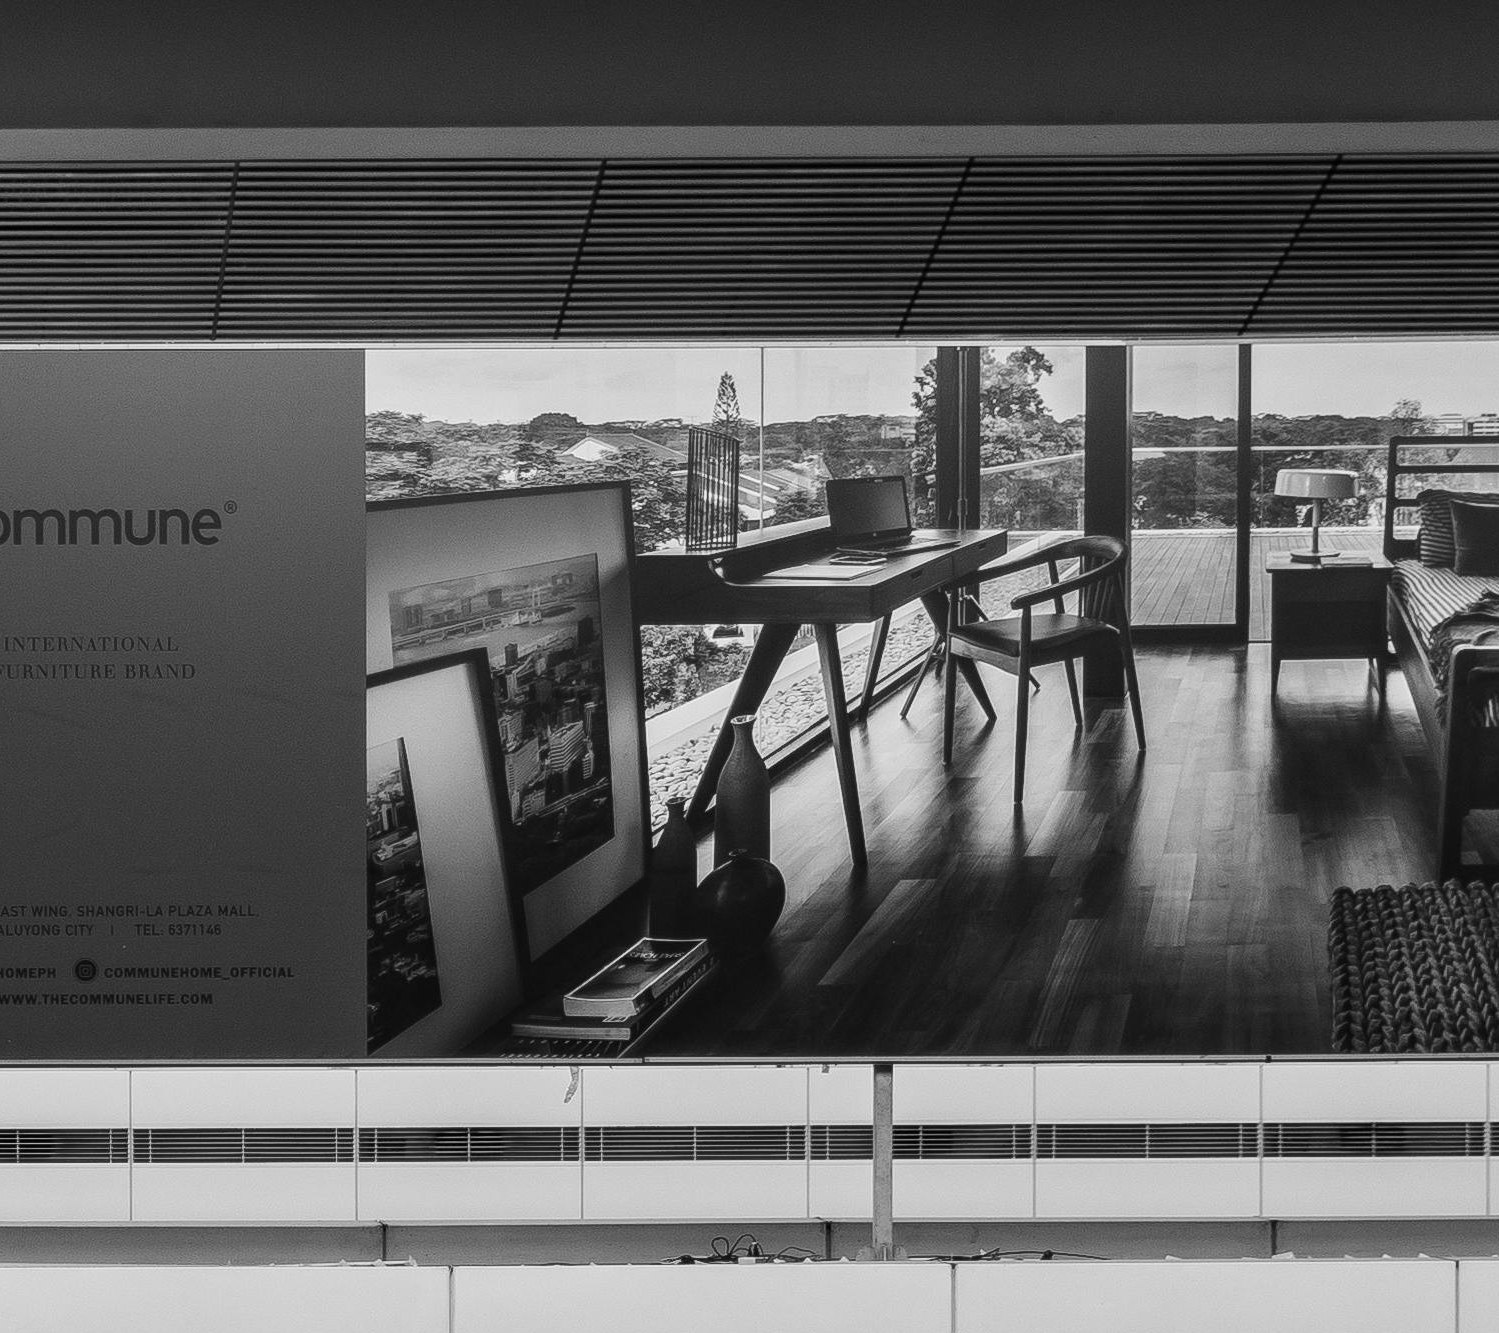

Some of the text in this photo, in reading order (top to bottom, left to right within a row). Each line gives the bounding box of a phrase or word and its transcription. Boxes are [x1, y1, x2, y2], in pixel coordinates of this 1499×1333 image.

[4, 636, 179, 652] INTERNATIONAL
[124, 663, 196, 680] BRAND
[76, 905, 164, 917] SHANGRI-LA
[168, 905, 213, 917] PLAZA
[65, 924, 94, 936] CITY
[134, 924, 164, 936] TEL:
[168, 924, 222, 936] 6371146
[104, 967, 295, 981] COMMUNEHOME_OFFICIAL
